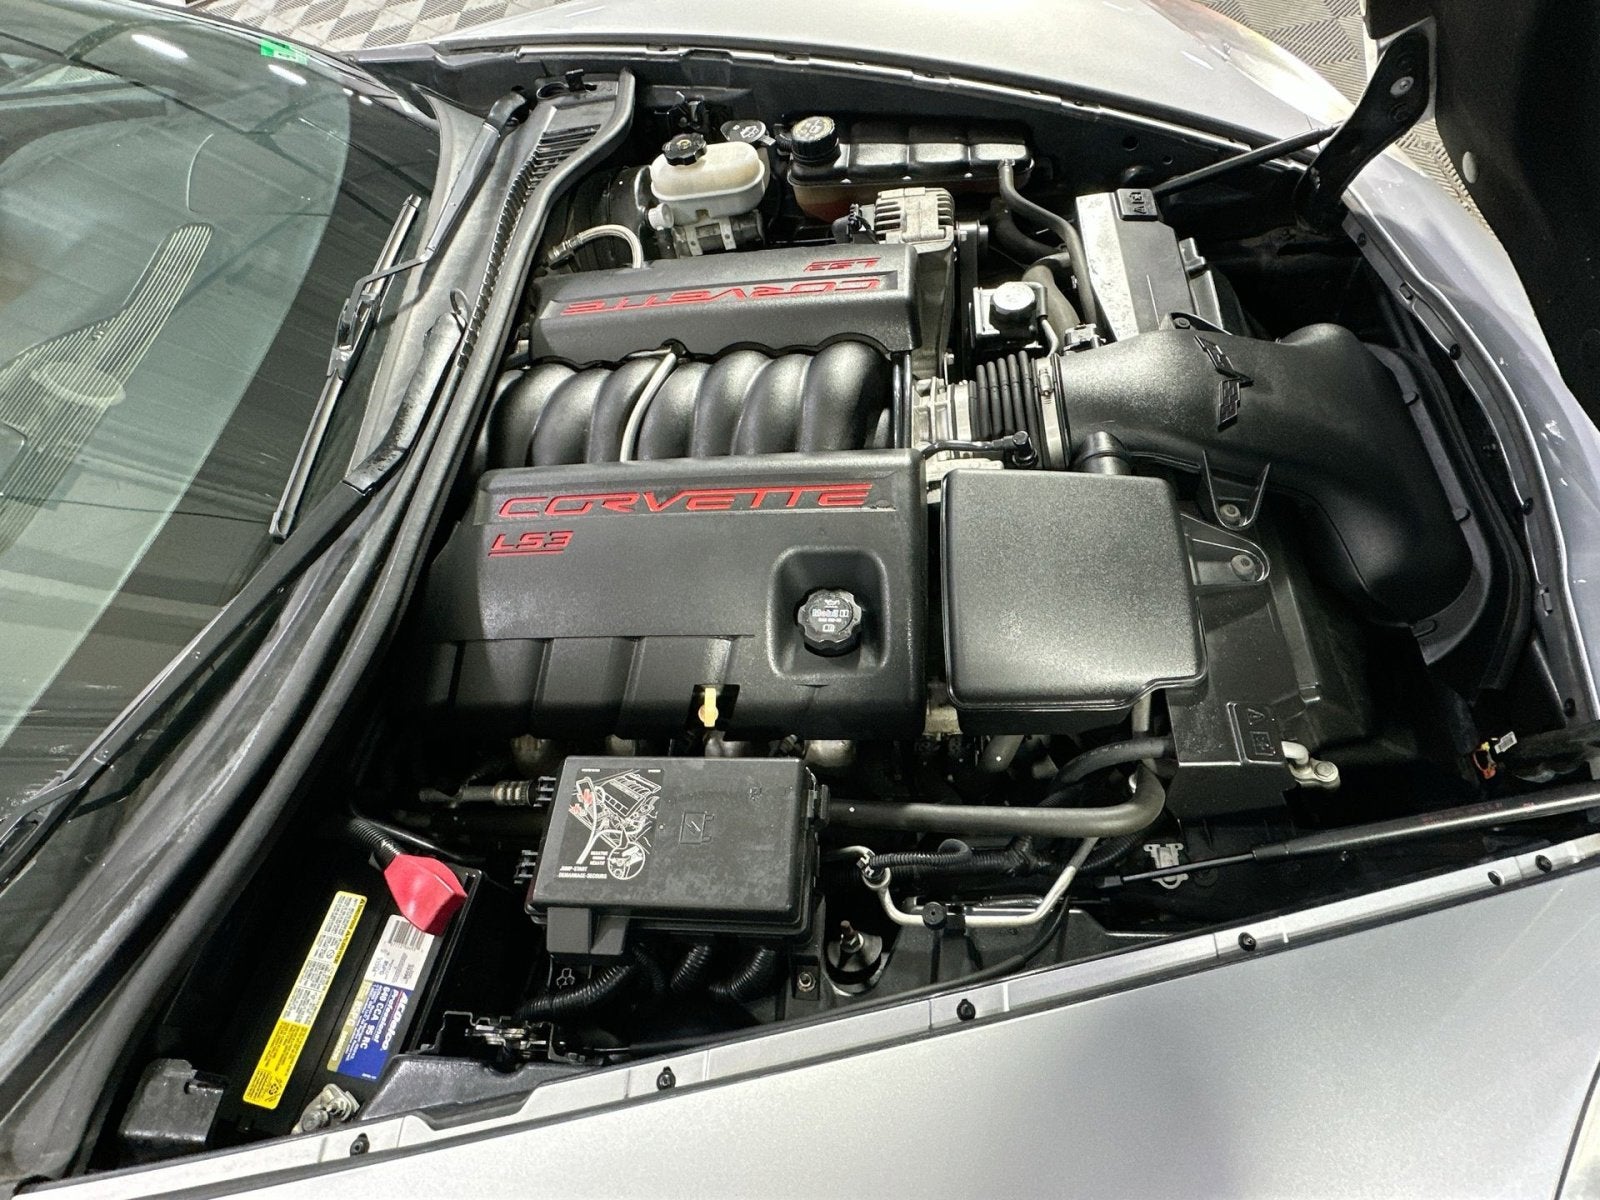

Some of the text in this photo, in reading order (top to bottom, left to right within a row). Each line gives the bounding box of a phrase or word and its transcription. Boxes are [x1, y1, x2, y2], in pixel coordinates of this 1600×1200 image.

[804, 257, 881, 272] LS3
[561, 278, 881, 316] CORVETTE
[498, 482, 873, 517] CORVETTE
[489, 529, 574, 556] LS3
[370, 1001, 384, 1022] CCA
[373, 989, 399, 1042] Professional
[380, 992, 408, 1050] ACDelco
[359, 1035, 370, 1049] RC
